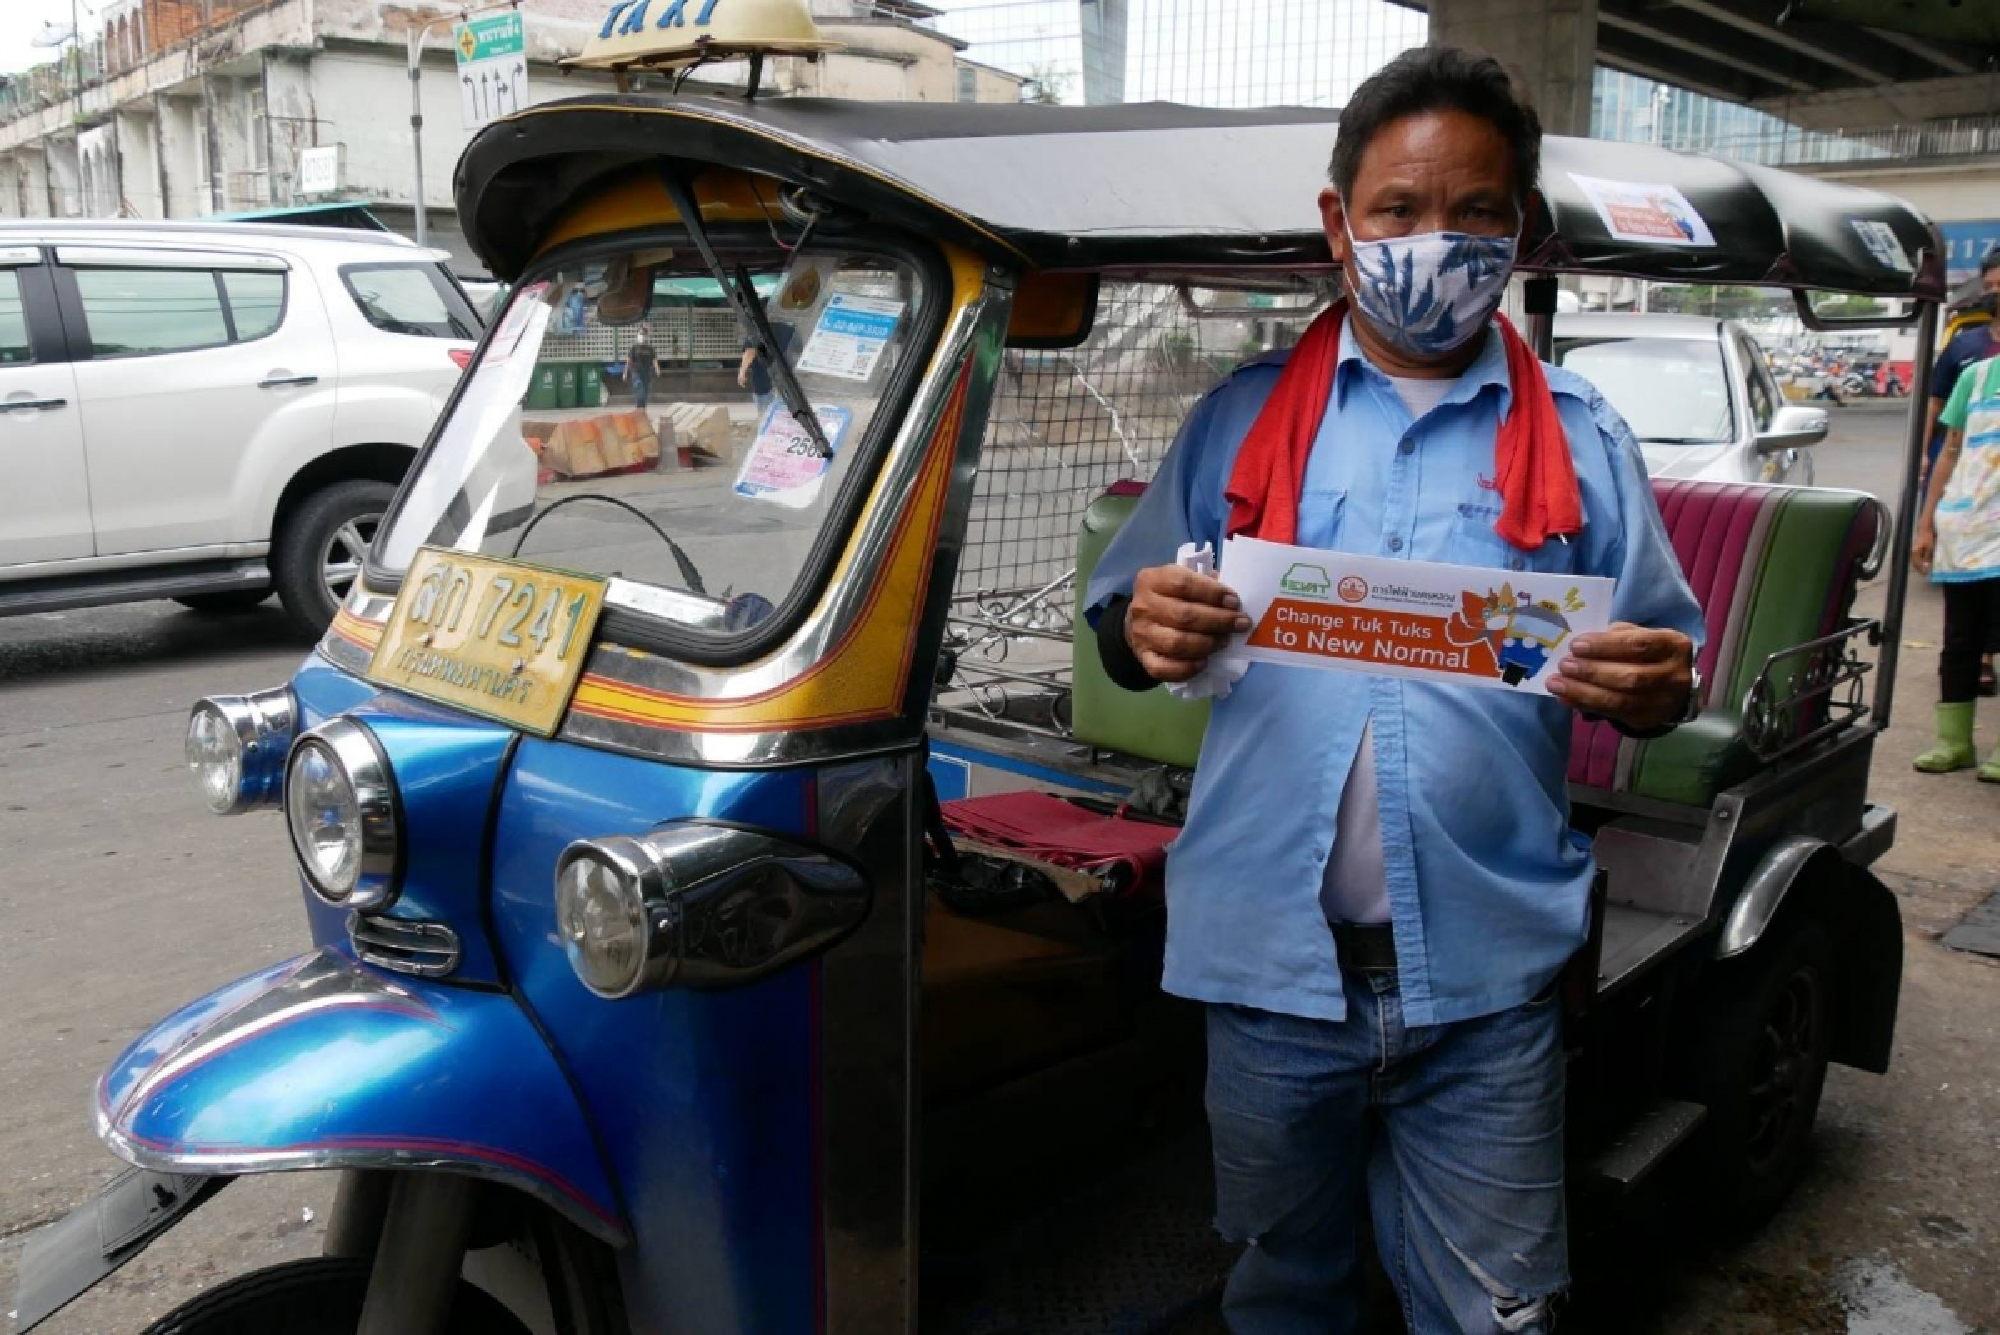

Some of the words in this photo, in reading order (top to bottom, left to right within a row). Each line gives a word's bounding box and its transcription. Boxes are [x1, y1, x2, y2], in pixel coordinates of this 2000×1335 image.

[598, 0, 719, 39] TAXI
[478, 577, 588, 660] 7241
[1276, 607, 1344, 631] Change
[1352, 616, 1383, 633] Tuk
[1390, 619, 1432, 639] Tuks
[1273, 626, 1298, 646] to
[1307, 630, 1364, 656] New
[1372, 639, 1470, 669] Normal
[398, 648, 533, 704] กรุงเทพมหานคร
